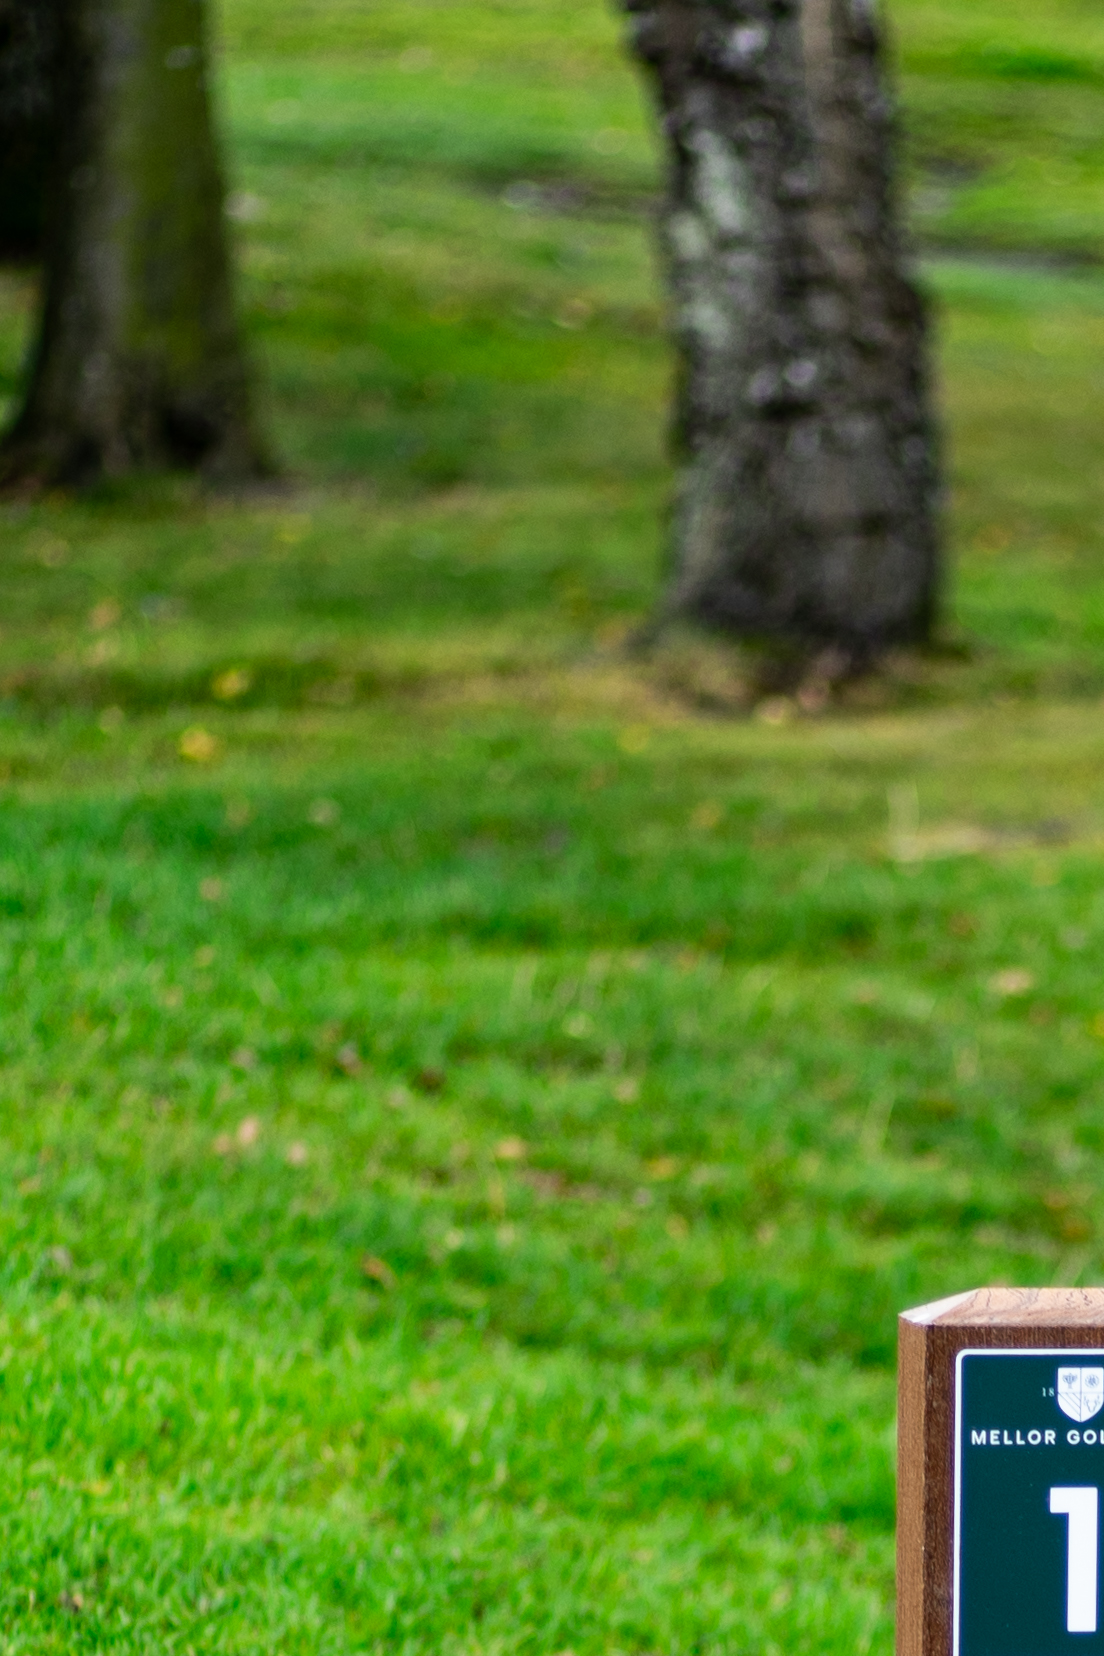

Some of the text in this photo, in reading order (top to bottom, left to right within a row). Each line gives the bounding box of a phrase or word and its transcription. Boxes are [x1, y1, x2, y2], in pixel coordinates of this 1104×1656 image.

[1042, 1387, 1055, 1397] 18
[971, 1429, 1057, 1446] MELLOR
[1050, 1487, 1098, 1632] 1
